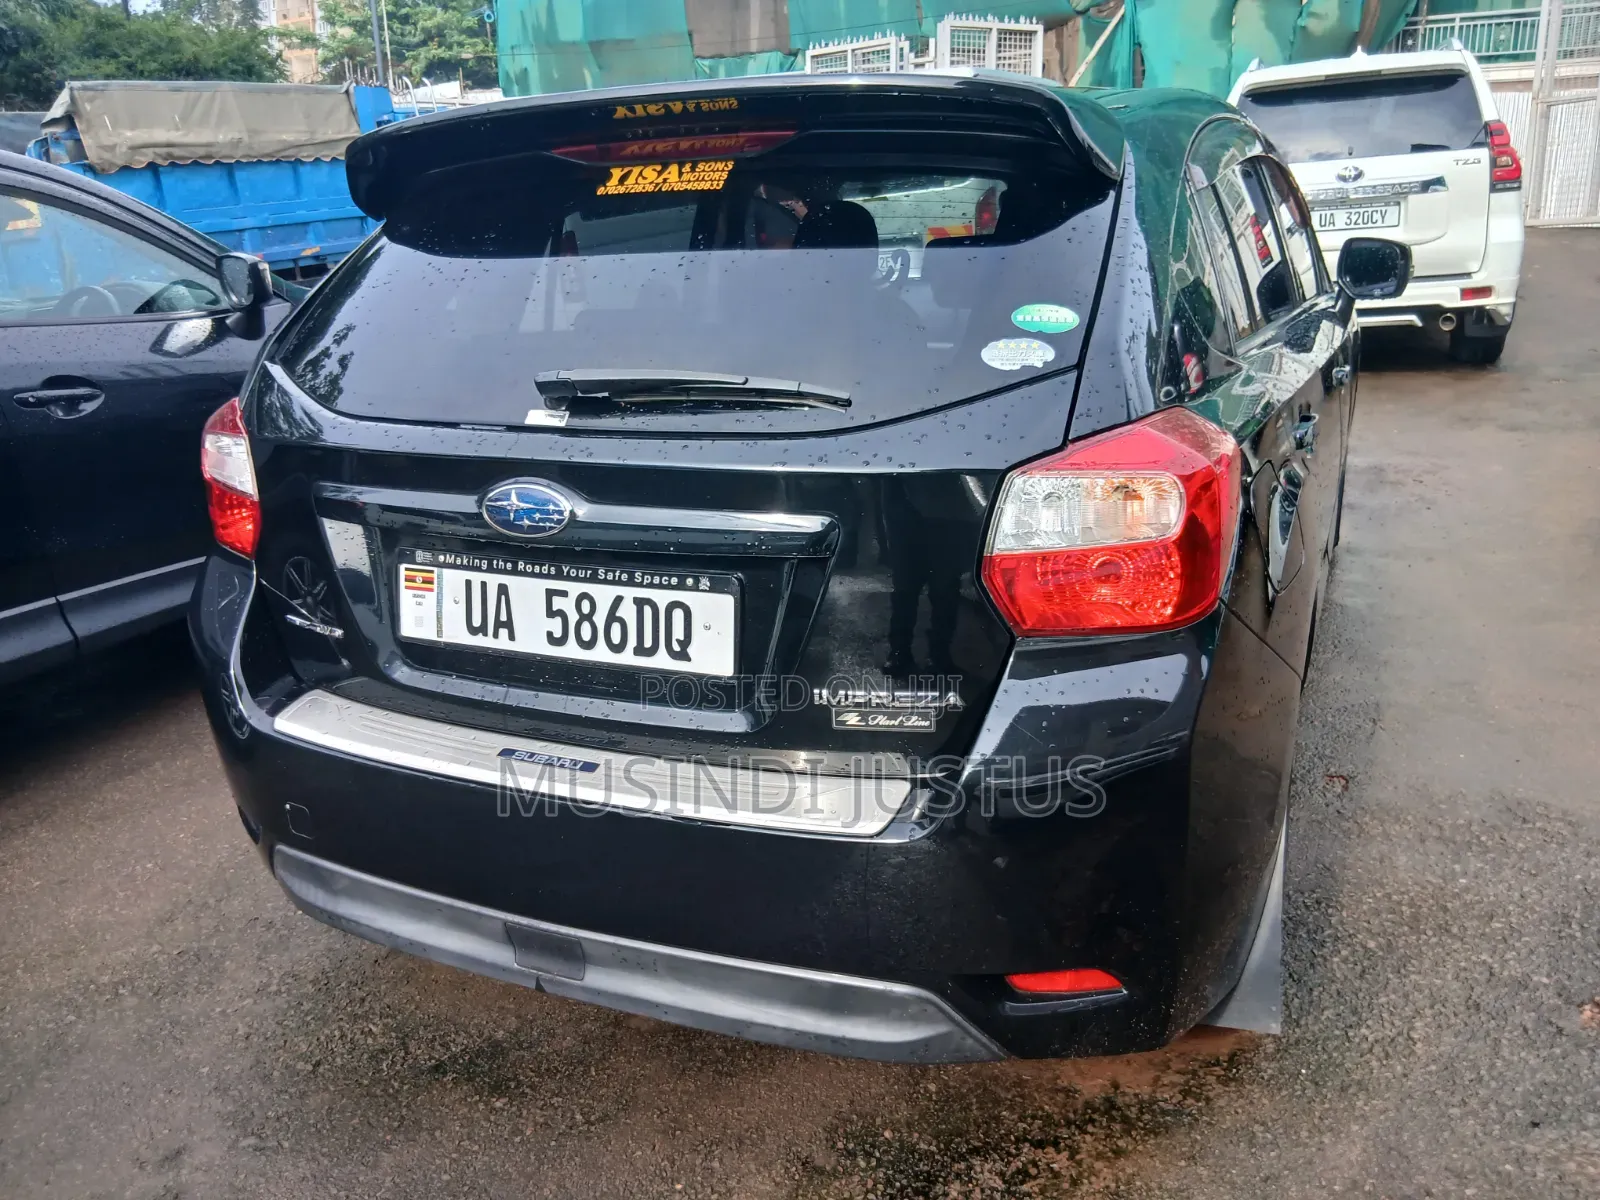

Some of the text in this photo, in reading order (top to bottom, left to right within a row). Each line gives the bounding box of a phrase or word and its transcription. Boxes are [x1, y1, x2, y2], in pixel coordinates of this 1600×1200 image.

[606, 161, 734, 187] YISA & SONS
[680, 171, 729, 182] MOTORS
[1319, 209, 1388, 228] UA 320CY
[445, 554, 488, 569] Making
[493, 559, 512, 571] the
[517, 561, 556, 575] Roads
[562, 565, 592, 579] Your
[597, 569, 628, 582] Safe
[634, 572, 679, 585] Space
[465, 578, 693, 663] UA 586DQ
[813, 688, 967, 708] IMPREZA
[868, 714, 931, 727] Start Line
[512, 751, 584, 770] SUBARU
